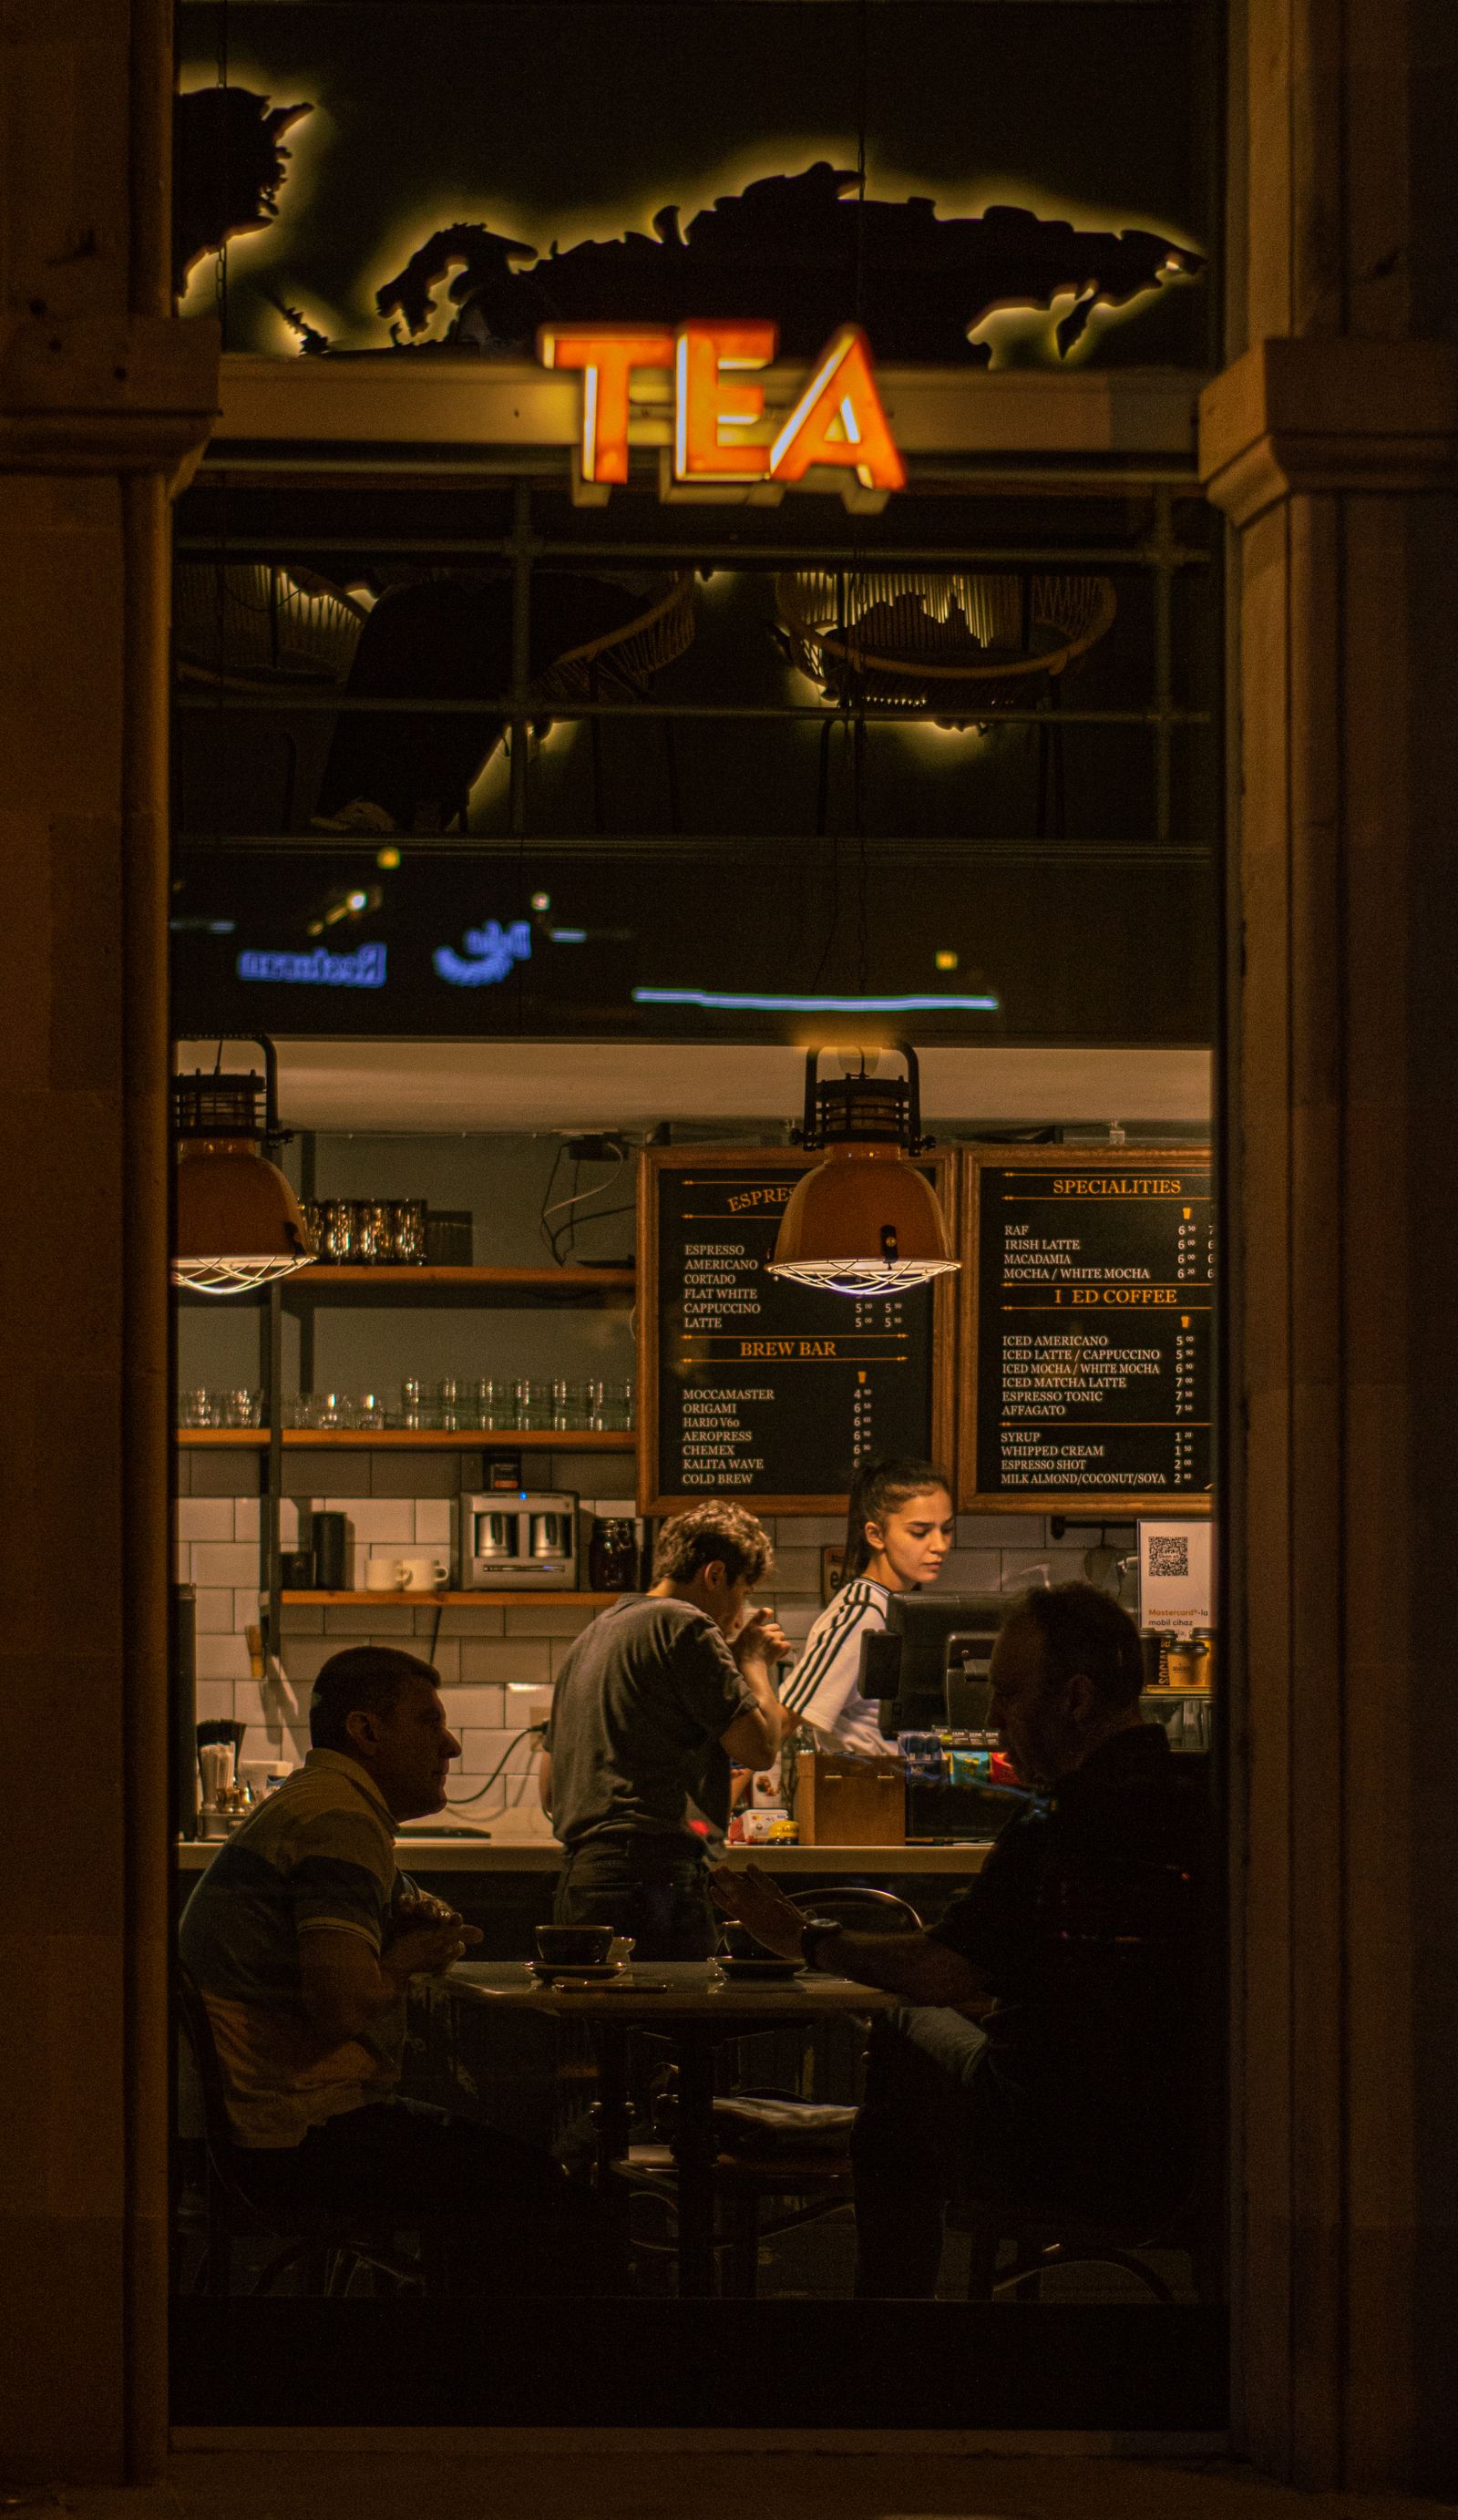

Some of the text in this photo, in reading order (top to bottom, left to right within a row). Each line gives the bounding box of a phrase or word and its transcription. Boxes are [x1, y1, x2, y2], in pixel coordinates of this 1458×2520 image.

[541, 326, 908, 490] TEA
[1054, 1180, 1181, 1194] SPECIALITIES
[1005, 1226, 1029, 1235] RAF
[1006, 1239, 1039, 1250] IRISH
[1042, 1239, 1080, 1250] LATTE
[685, 1245, 744, 1255] ESPRESSO
[1004, 1254, 1071, 1264] MACADAMIA
[685, 1260, 758, 1270] AMERICANO
[1004, 1269, 1049, 1278] MOCHA
[1061, 1269, 1102, 1278] WHITE
[1104, 1269, 1150, 1278] MOCHA
[684, 1274, 735, 1284] CORTADO
[684, 1289, 757, 1299] FLAT WHITE
[1104, 1290, 1176, 1303] COFFEE
[683, 1303, 760, 1313] CAPPUCCINO
[685, 1318, 722, 1328] LATTE
[1003, 1336, 1032, 1346] ICED
[1034, 1336, 1107, 1346] AMERICANO
[741, 1342, 836, 1356] BREW BAR
[1003, 1350, 1032, 1360] ICED
[1035, 1350, 1073, 1361] LATTE
[1083, 1350, 1161, 1360] CAPPUCCINO
[1003, 1363, 1028, 1373] ICED
[1032, 1364, 1073, 1374] MOCHA
[1080, 1363, 1118, 1373] WHITE
[1119, 1363, 1159, 1373] MOCHA
[1003, 1378, 1032, 1387] ICED
[1034, 1377, 1086, 1387] MATCHA
[1089, 1378, 1126, 1387] LATTE
[683, 1390, 774, 1400] MOCCAMASTER
[1002, 1392, 1062, 1401] ESPRESSO
[1064, 1392, 1103, 1401] TONIC
[683, 1404, 736, 1414] ORIGAMI
[1002, 1405, 1065, 1414] AFFAGATO
[684, 1418, 718, 1427] HARIO
[683, 1432, 752, 1441] AEROPRESS
[1001, 1433, 1040, 1442] SYRUP
[683, 1445, 734, 1455] CHEMEX
[1001, 1446, 1060, 1455] WHIPPED
[1061, 1446, 1104, 1455] CREAM
[683, 1459, 764, 1469] KALITA WAVE
[1001, 1460, 1054, 1469] ESPRESSO
[1057, 1460, 1086, 1469] SHOT
[683, 1474, 753, 1484] COLD BREW
[1001, 1474, 1030, 1484] MILK
[1031, 1474, 1165, 1485] ALMOND/COCONUT/SOYA
